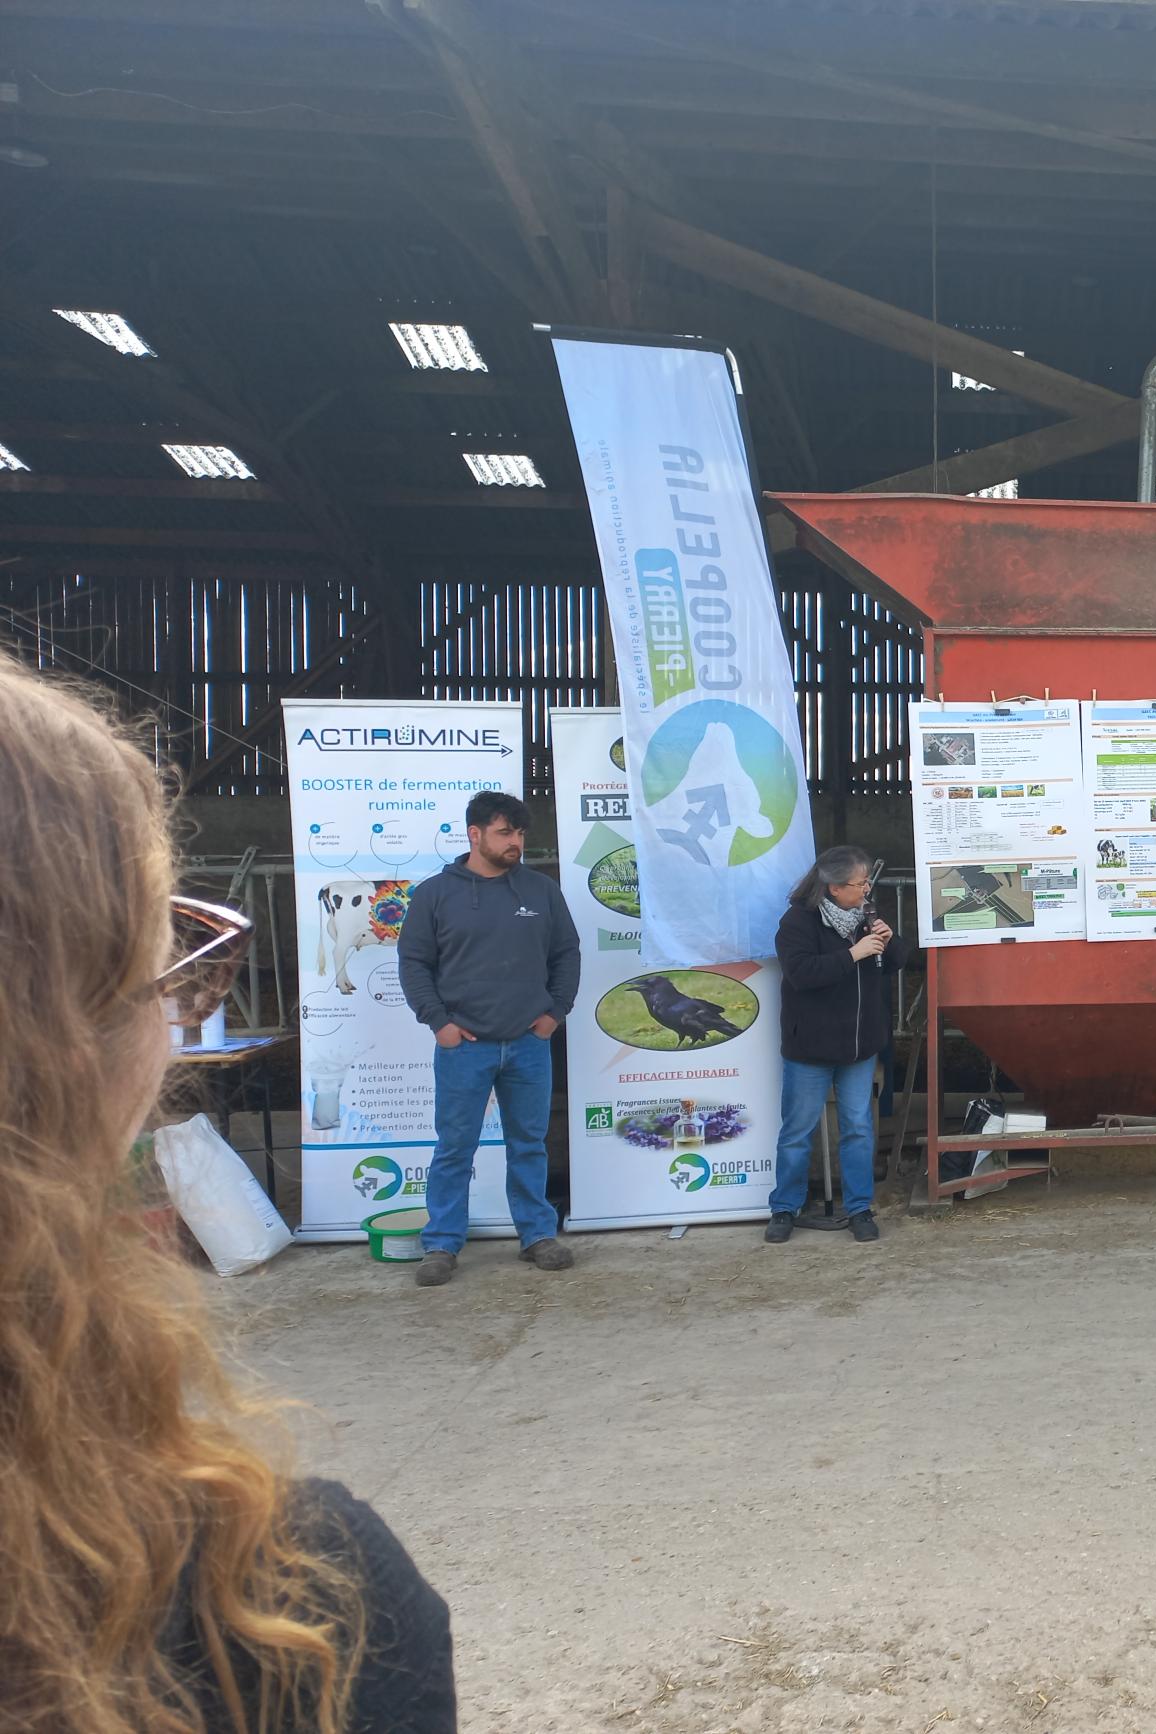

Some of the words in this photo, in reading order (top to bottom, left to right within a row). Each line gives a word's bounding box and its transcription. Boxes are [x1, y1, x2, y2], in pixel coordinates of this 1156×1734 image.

[301, 779, 373, 791] BOOSTER
[378, 778, 398, 791] de
[402, 777, 502, 791] fermentation
[368, 798, 436, 811] ruminale
[358, 1063, 405, 1071] Meilleure
[359, 1074, 403, 1083] lactation
[618, 1071, 684, 1083] EFFICACITE
[686, 1068, 740, 1079] DURABLE
[359, 1087, 404, 1096] Améliore
[359, 1099, 404, 1108] Optimise
[407, 1098, 420, 1106] les
[616, 1099, 658, 1108] Fragrances
[360, 1110, 424, 1120] reproduction
[616, 1107, 656, 1117] d'essences
[656, 1106, 665, 1114] de
[587, 1113, 609, 1129] AB
[360, 1123, 414, 1132] Prévention
[711, 1159, 772, 1175] COOPELIA
